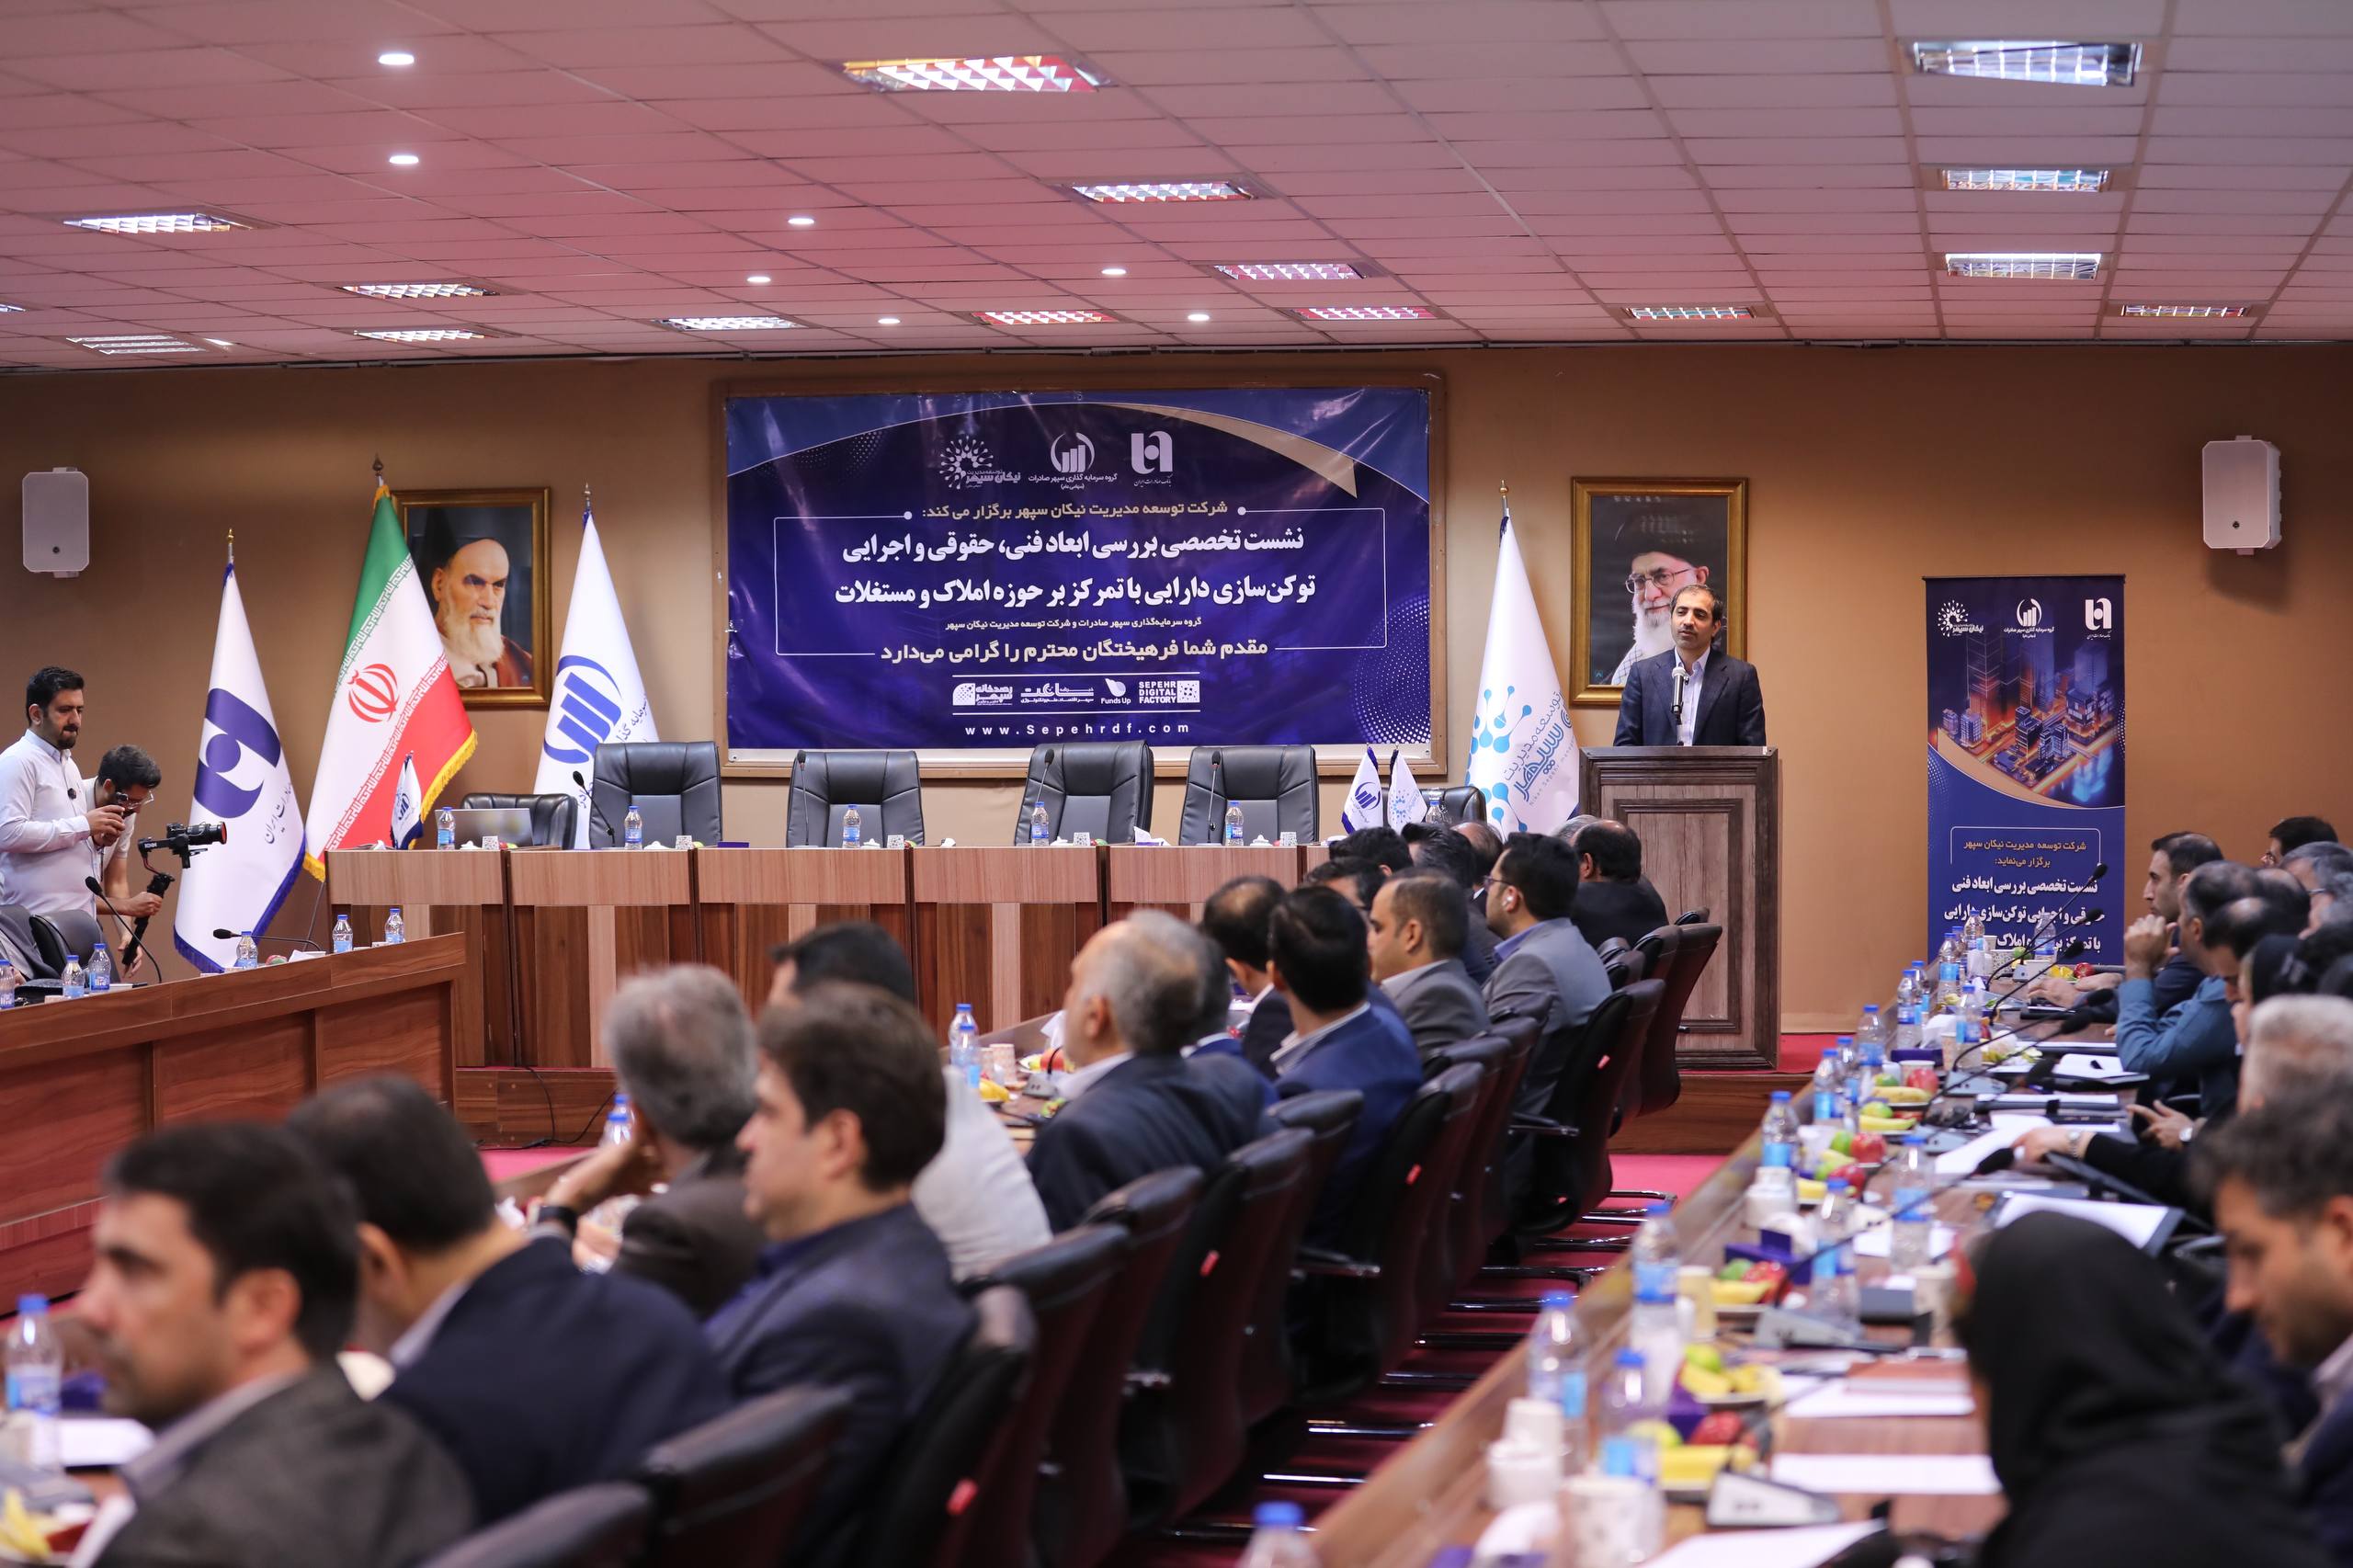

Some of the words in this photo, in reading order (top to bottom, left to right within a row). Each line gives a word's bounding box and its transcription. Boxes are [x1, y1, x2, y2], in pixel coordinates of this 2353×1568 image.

[994, 471, 1021, 483] نیکان
[1029, 474, 1050, 483] صادرات
[1065, 472, 1084, 483] گذاری
[1085, 473, 1104, 483] سرمایه
[1104, 472, 1118, 483] گروه
[972, 504, 1012, 520] برگزار
[1015, 505, 1048, 521] سپهر
[1051, 503, 1086, 518] نیکان
[1088, 504, 1139, 518] مدیریت
[1142, 503, 1185, 517] توسعه
[1187, 501, 1229, 517] شرکت
[926, 531, 995, 562] حقوقی
[998, 529, 1043, 561] فنی،
[1045, 529, 1089, 559] ابعاد
[1092, 535, 1158, 559] بررسی
[1160, 528, 1242, 559] تخصصی
[1244, 527, 1305, 551] نشست
[842, 533, 911, 562] اجرایی
[913, 541, 926, 562] و
[835, 579, 916, 603] مستغلات
[918, 588, 931, 609] و
[932, 578, 991, 603] املاک
[993, 582, 1044, 608] حوزه
[1045, 583, 1066, 608] بر
[1068, 577, 1125, 608] تمرکز
[1126, 576, 1142, 605] با
[1143, 575, 1211, 606] دارایی
[945, 621, 965, 631] سپهر
[966, 619, 988, 631] نیکان
[989, 620, 1019, 630] مدیریت
[1020, 619, 1046, 630] توسعه
[1046, 619, 1071, 629] شرکت
[1077, 619, 1108, 629] صادرات
[1109, 619, 1131, 629] سپهر
[1183, 617, 1202, 628] گروه
[948, 639, 1000, 664] گرامی
[1004, 642, 1019, 664] را
[1023, 642, 1078, 664] محترم
[1082, 638, 1179, 662] فرهیختگان
[1183, 639, 1217, 656] شما
[1219, 639, 1268, 660] مقدم
[1100, 697, 1120, 705] Funds
[1120, 697, 1131, 706] Up
[965, 722, 1189, 736] www.Sepehrdf.com
[1504, 733, 1539, 781] مدیریت
[1513, 722, 1564, 802] سپهر
[1963, 840, 1983, 851] سپهر
[1984, 840, 2005, 850] نیکان
[2006, 840, 2035, 850] مدیریت
[2037, 842, 2062, 851] توسعه
[2063, 841, 2086, 852] شرکت
[2028, 857, 2052, 868] برگزار
[1951, 874, 1972, 893] فنی
[1972, 876, 1994, 893] ابعاد
[1994, 881, 2027, 895] بررسی
[2027, 879, 2067, 895] تخصصی
[2063, 913, 2070, 925] و
[1997, 933, 2026, 948] املاک
[2093, 936, 2102, 953] با
